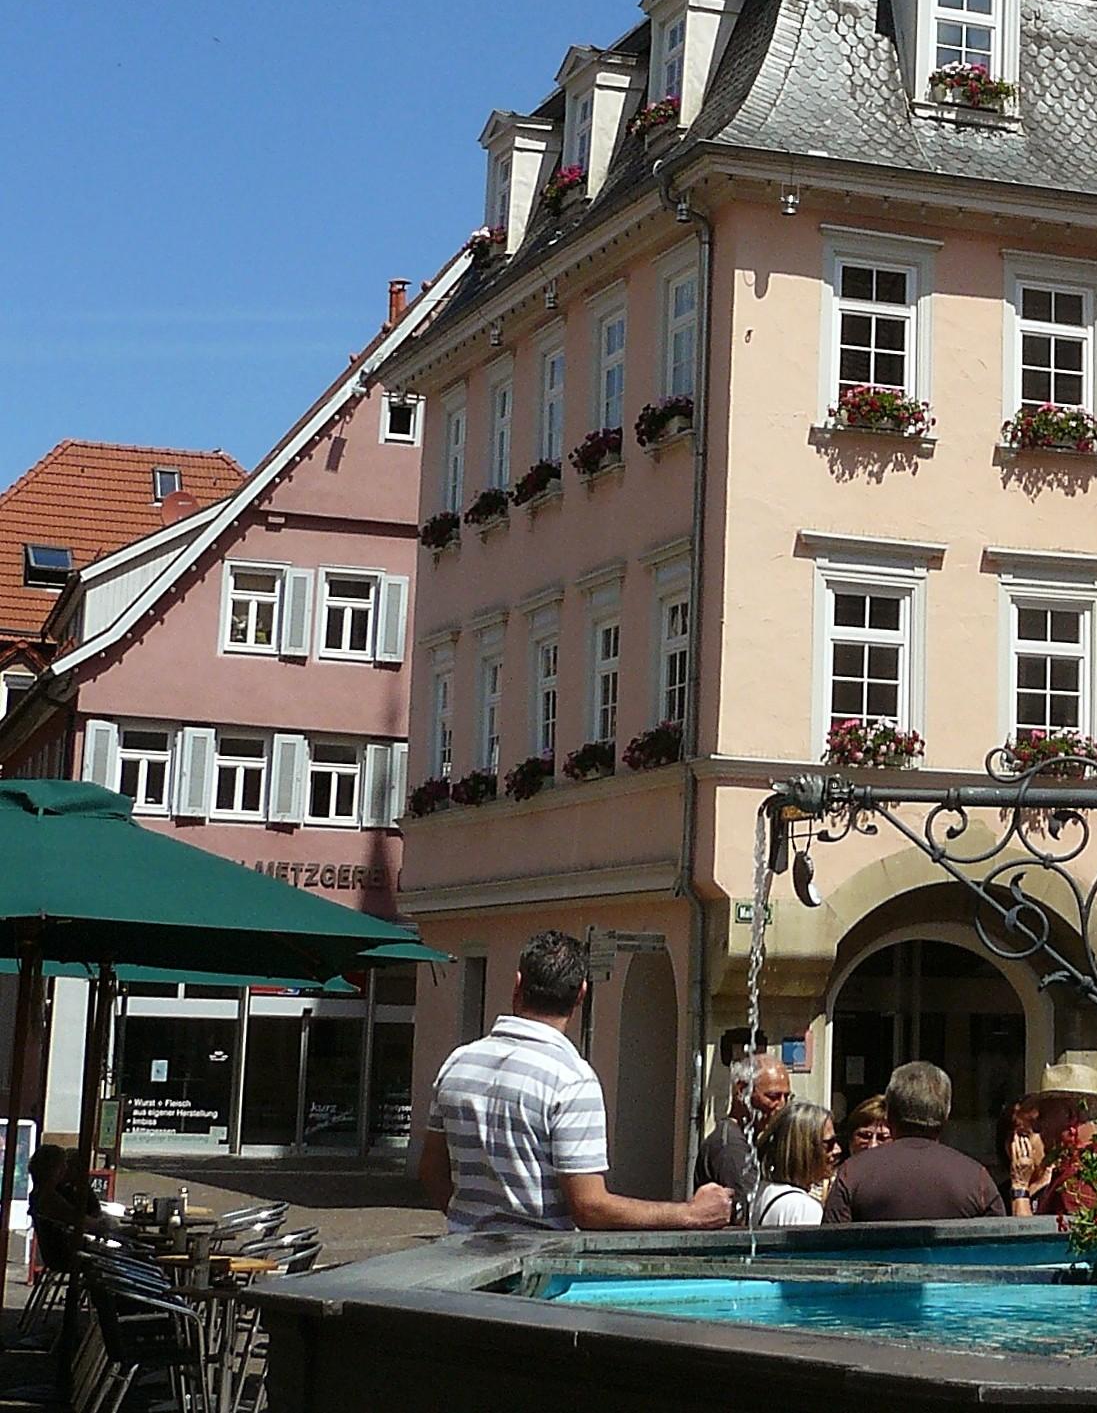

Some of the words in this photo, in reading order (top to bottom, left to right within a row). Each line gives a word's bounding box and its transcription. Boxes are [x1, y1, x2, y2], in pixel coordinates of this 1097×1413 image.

[134, 1098, 156, 1107] Wurst
[165, 1098, 192, 1108] Fleisch
[148, 1109, 175, 1118] eigener
[176, 1109, 218, 1119] Herstellung
